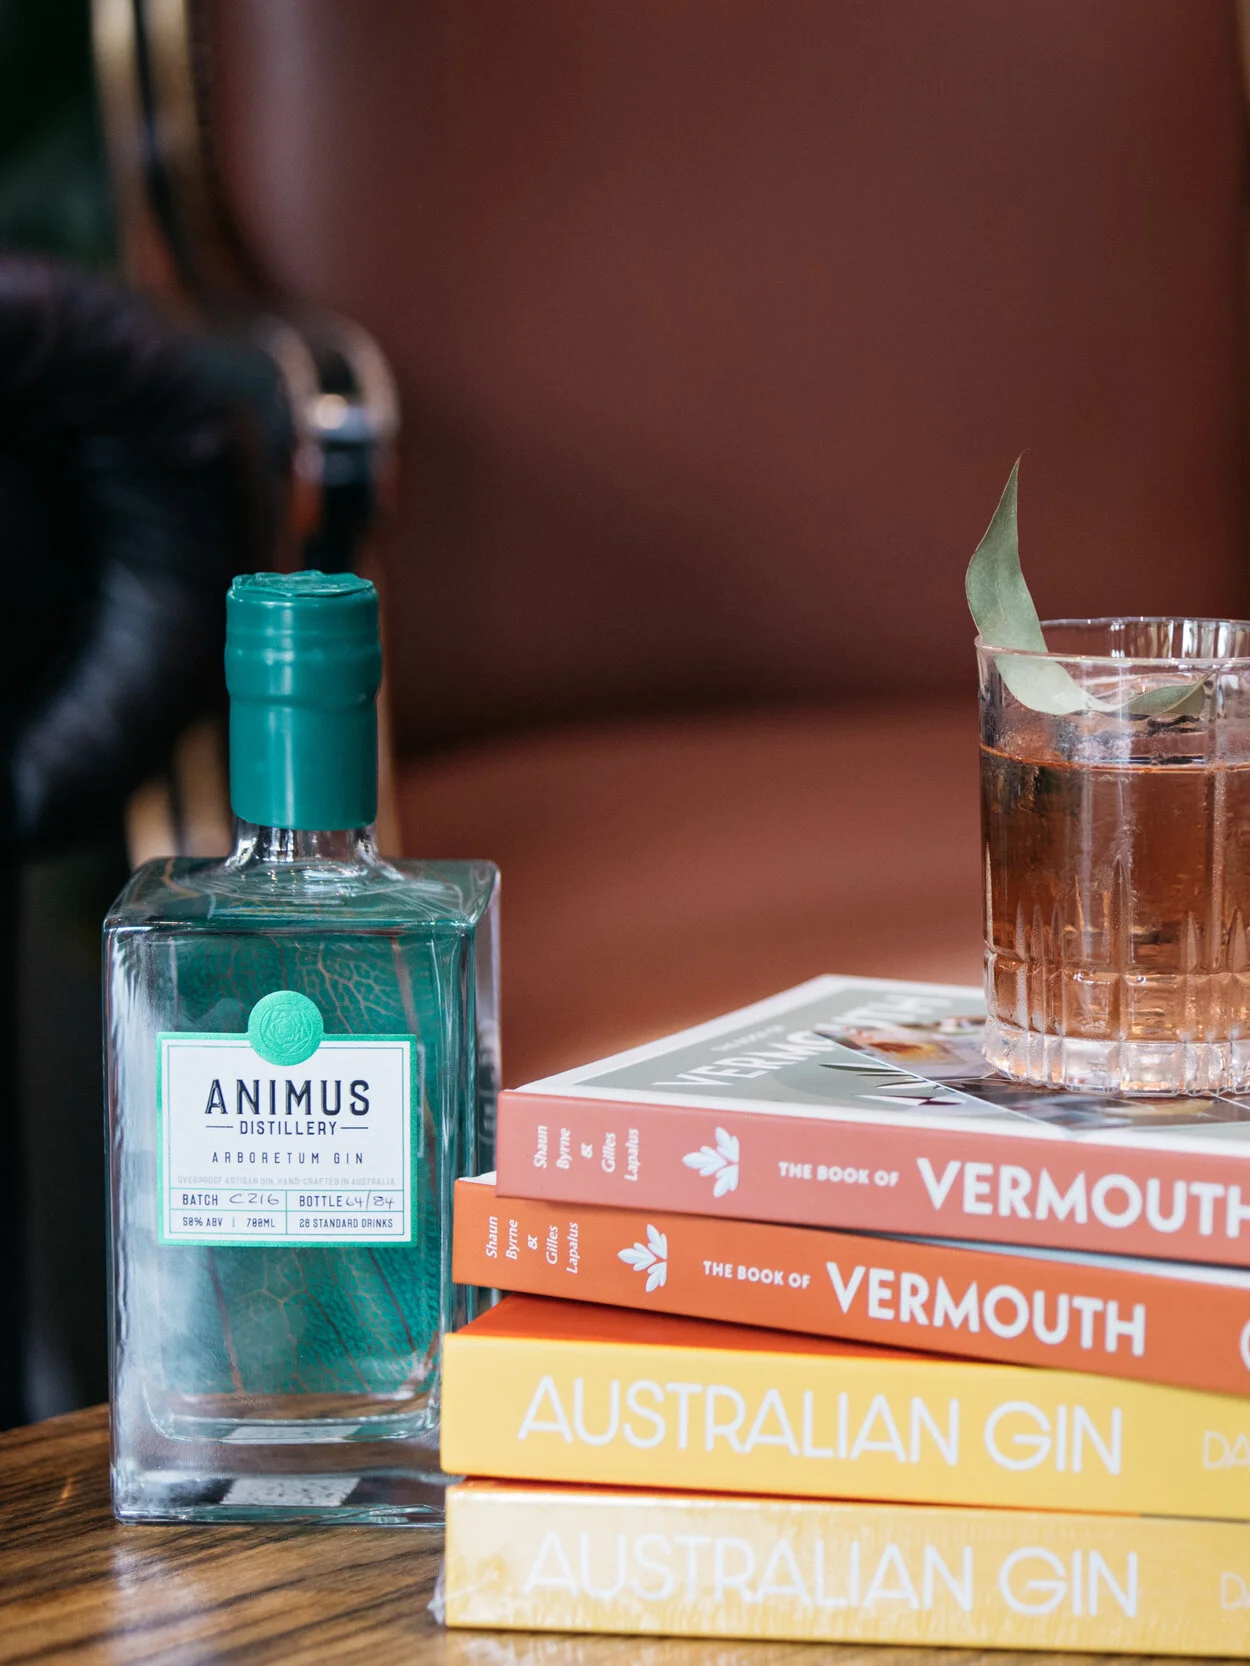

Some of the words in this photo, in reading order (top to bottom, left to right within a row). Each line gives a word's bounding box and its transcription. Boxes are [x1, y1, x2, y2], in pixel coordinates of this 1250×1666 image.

[204, 1078, 370, 1116] ANIMUS
[239, 1120, 337, 1136] DISTILLERY
[533, 1125, 548, 1169] Shaun
[211, 1151, 320, 1165] ARBORETUM
[333, 1152, 364, 1165] GIN
[556, 1127, 571, 1170] Byrne
[580, 1142, 593, 1159] &
[601, 1132, 616, 1173] Gilles
[624, 1128, 639, 1181] Lapalus
[778, 1161, 812, 1180] THE
[817, 1165, 869, 1185] BOOK
[874, 1170, 899, 1187] OF
[182, 1194, 219, 1206] BATCH
[299, 1195, 343, 1208] BOTTLE
[182, 1217, 204, 1228] 50%
[206, 1217, 223, 1228] ABV
[246, 1217, 276, 1228] 700ML
[299, 1218, 311, 1228] 28
[313, 1218, 359, 1228] STANDARD
[361, 1218, 394, 1228] DRINKS
[486, 1216, 498, 1259] Shaun
[505, 1219, 518, 1260] Byrne
[527, 1234, 538, 1250] &
[546, 1225, 558, 1265] Gilles
[566, 1222, 579, 1274] Lapalus
[703, 1260, 733, 1279] THE
[737, 1265, 784, 1286] BOOK
[788, 1273, 811, 1289] OF
[826, 1261, 1146, 1357] VERMOUTH
[517, 1375, 960, 1466] AUSTRALIAN
[983, 1400, 1123, 1475] GIN
[522, 1531, 973, 1613] AUSTRALIAN
[998, 1546, 1138, 1618] GIN
